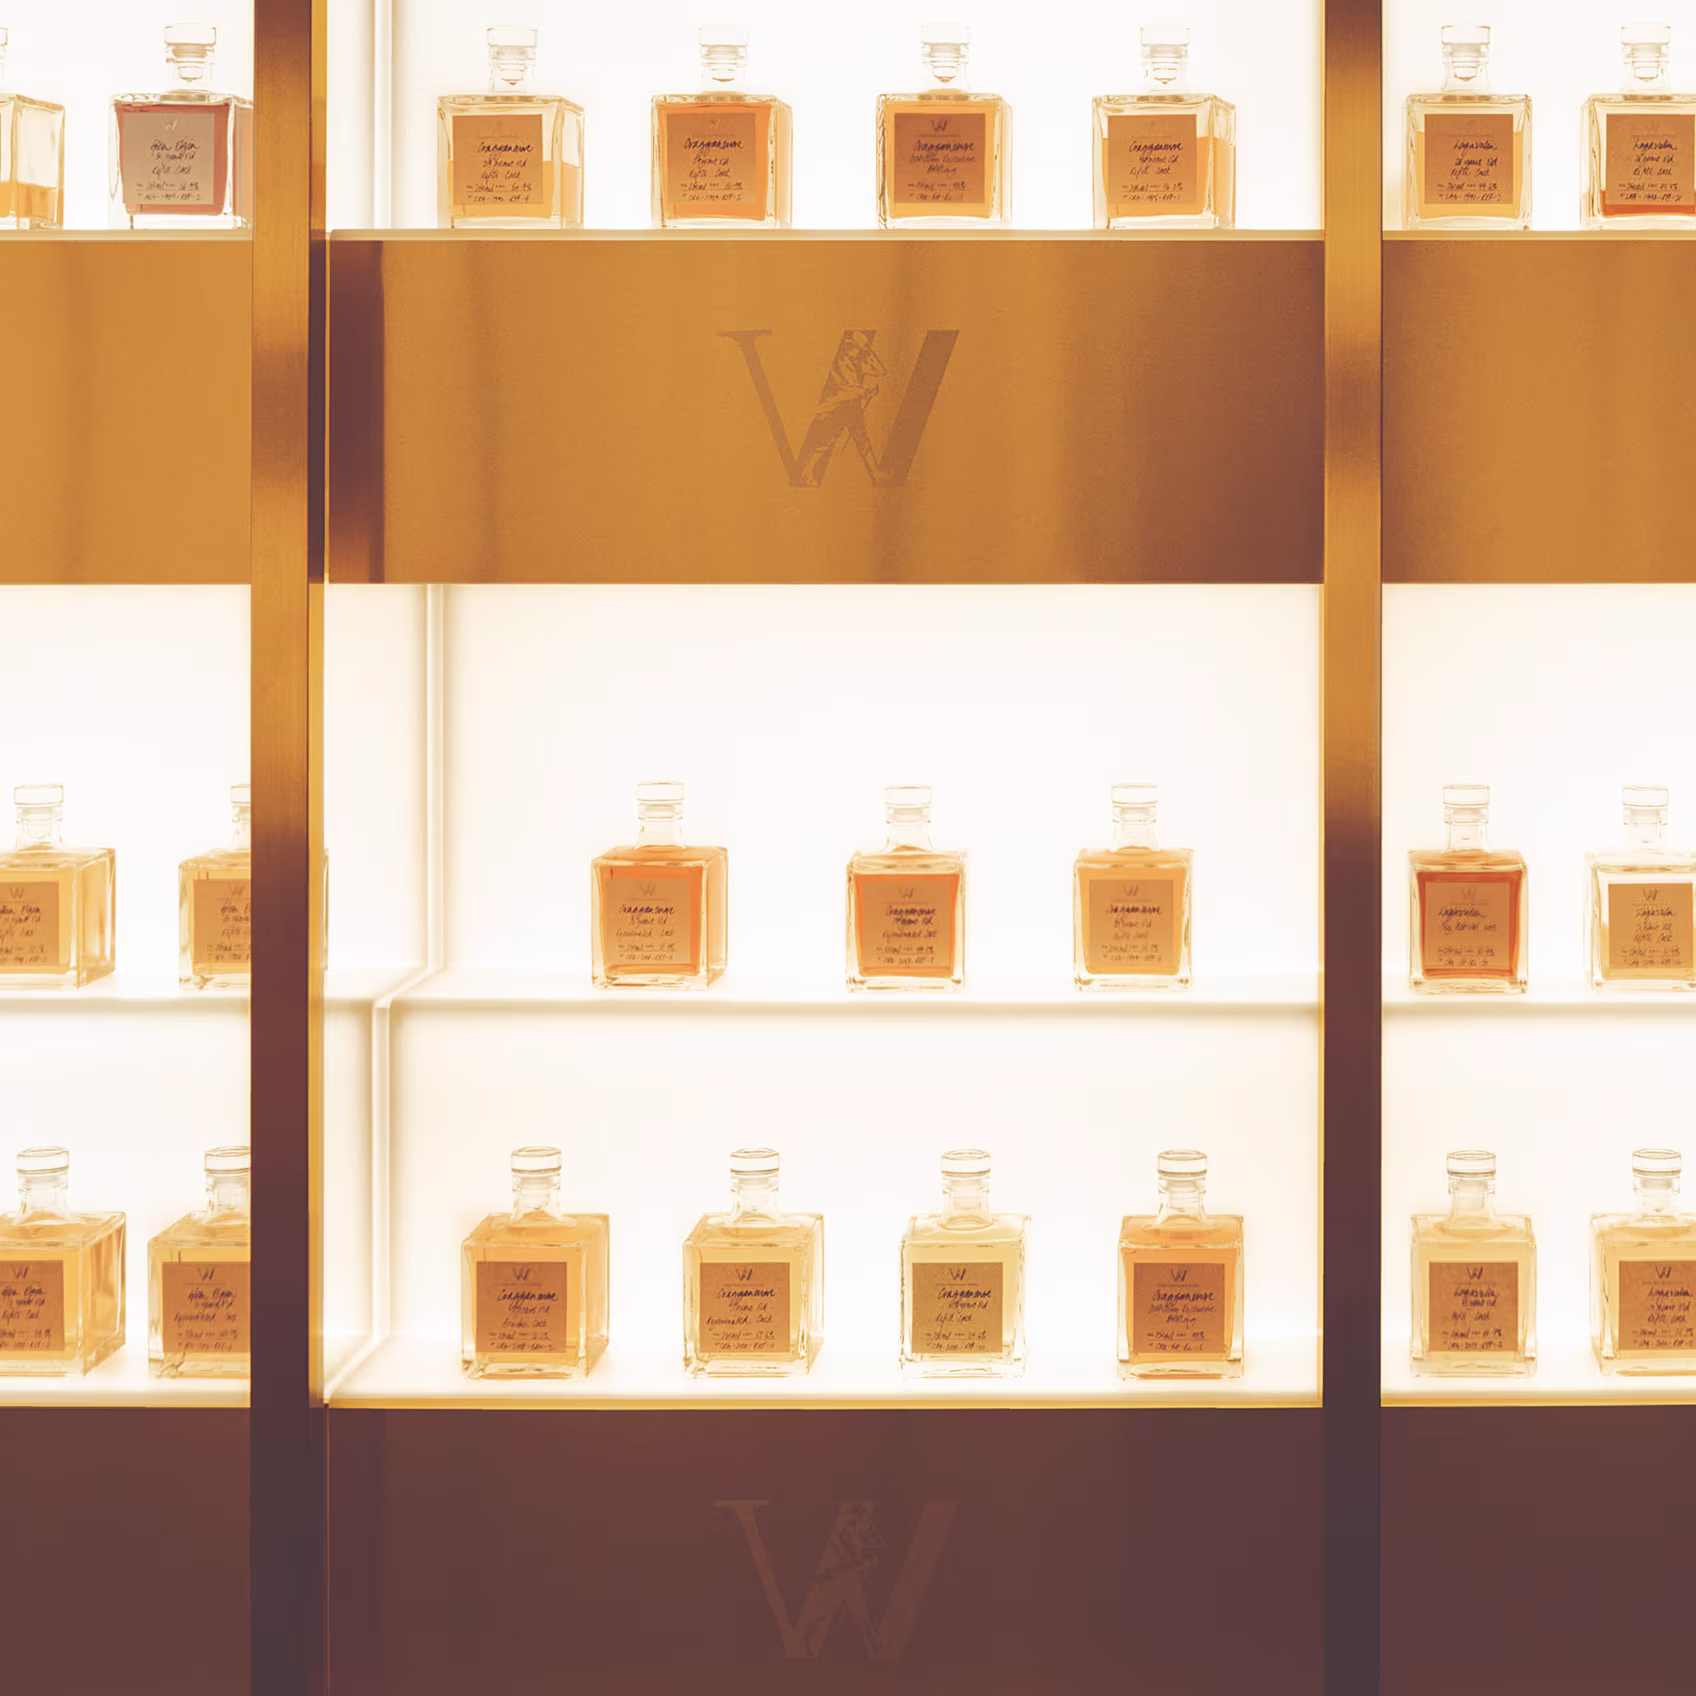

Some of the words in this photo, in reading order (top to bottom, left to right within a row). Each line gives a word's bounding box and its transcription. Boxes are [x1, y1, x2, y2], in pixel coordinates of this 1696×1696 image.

[717, 329, 960, 488] W
[513, 1267, 530, 1281] W
[736, 1268, 753, 1281] W
[949, 1268, 967, 1281] W
[1170, 1268, 1187, 1281] W
[1466, 1266, 1484, 1280] W
[1655, 1266, 1672, 1279] W
[717, 1500, 958, 1658] W
